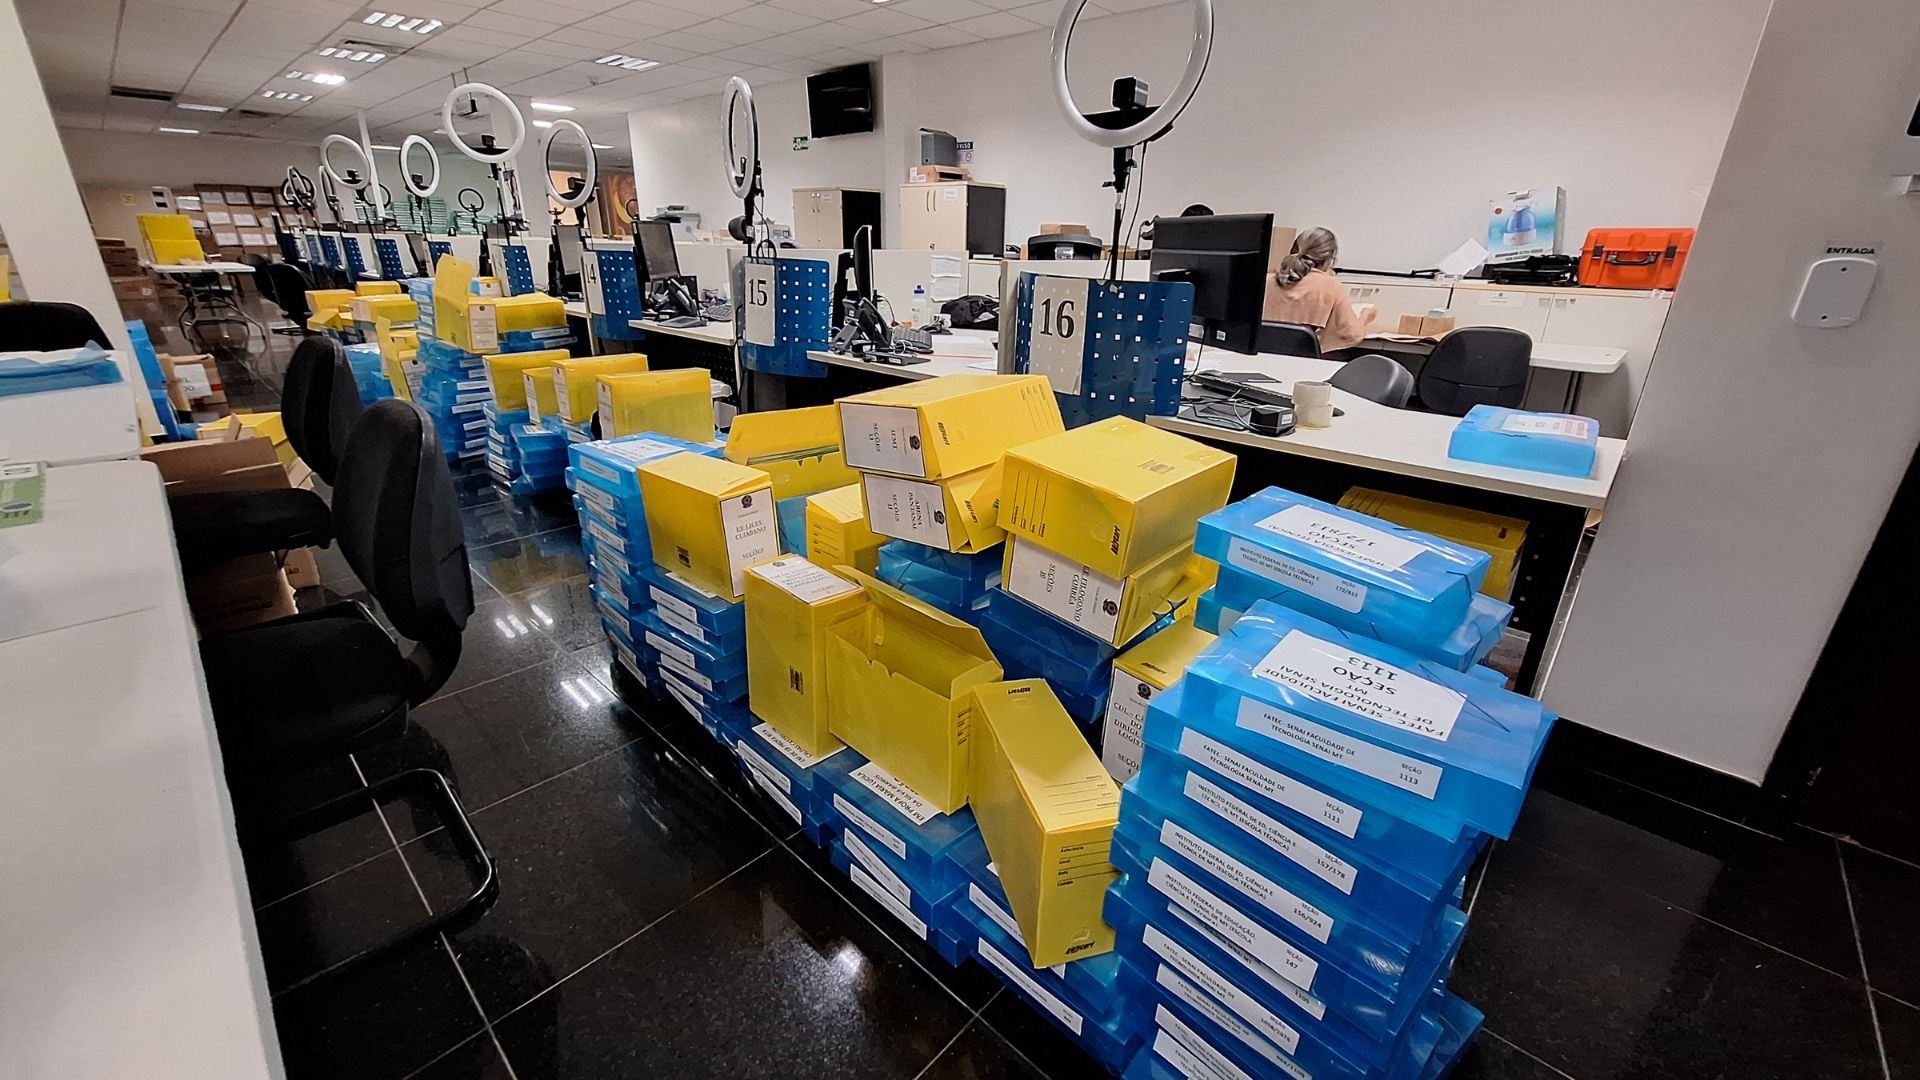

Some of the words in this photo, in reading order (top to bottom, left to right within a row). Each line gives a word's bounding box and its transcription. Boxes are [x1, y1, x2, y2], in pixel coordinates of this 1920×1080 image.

[1826, 247, 1875, 255] ENTRADA
[586, 263, 597, 284] 14
[748, 278, 768, 307] 15
[1040, 297, 1075, 339] 16
[1239, 546, 1261, 558] INSTITUTO
[1262, 554, 1281, 566] FEDERAL
[1047, 563, 1057, 594] SEÇÕES
[1069, 574, 1080, 606] CORRÊA
[1279, 664, 1317, 684] SENAI
[1346, 655, 1398, 681] 1113
[1261, 666, 1339, 702] FACULDADE
[1331, 664, 1397, 695] SEÇÃO
[1345, 683, 1368, 695] MT
[1319, 681, 1409, 718] TECNOLOGIA
[1341, 699, 1384, 718] SENAI
[1395, 717, 1443, 736] FATEC
[1412, 714, 1432, 725] DE
[1263, 713, 1282, 725] FATEC
[1286, 722, 1306, 735] SENAI
[1306, 731, 1345, 751] FACULDADE
[1345, 747, 1355, 756] DE
[1270, 724, 1311, 746] TECNOLOGIA
[1311, 742, 1331, 754] SENAI
[1331, 750, 1343, 759] MT
[1202, 744, 1220, 757] FATEC
[1223, 755, 1241, 768] SENAI
[1241, 764, 1275, 786] FACULDADE
[1275, 783, 1285, 791] DE
[1209, 755, 1246, 778] TECNOLOGIA
[1245, 775, 1264, 788] SENAI
[1263, 785, 1274, 793] MT
[1400, 762, 1422, 775] SEÇÃO
[856, 771, 876, 785] LUCILA
[874, 773, 897, 790] BARROS
[1398, 772, 1419, 785] 1113
[875, 783, 895, 799] MARIA
[895, 788, 912, 801] SILVA
[893, 796, 914, 813] PROFA
[911, 799, 922, 808] DA
[1197, 783, 1226, 803] INSTITUTO
[1225, 800, 1249, 818] FEDERAL
[1248, 815, 1258, 823] DE
[1267, 825, 1292, 844] CIÊNCIA
[1325, 801, 1344, 814] SEÇÃO
[913, 811, 924, 821] EM
[1322, 810, 1341, 823] 1111
[1229, 810, 1240, 820] MT
[1238, 816, 1262, 834] (ESCOLA
[1261, 830, 1291, 851] TÉCNICA)
[1174, 831, 1202, 851] INSTITUTO
[1201, 848, 1226, 866] FEDERAL
[1226, 863, 1235, 871] DE
[1244, 874, 1270, 893] CIÊNCIA
[1315, 857, 1346, 880] 157/178
[1323, 852, 1343, 867] SEÇÃO
[1197, 853, 1207, 861] DE
[1206, 858, 1216, 867] MT
[1215, 864, 1240, 883] (ESCOLA
[1238, 878, 1268, 900] TÉCNICA)
[1164, 872, 1192, 894] INSTITUTO
[1191, 891, 1215, 910] FEDERAL
[1214, 908, 1224, 916] DE
[1164, 879, 1186, 897] CIÊNCIA
[1210, 912, 1219, 920] DE
[1218, 918, 1229, 927] MT
[1292, 907, 1322, 929] 156/924
[1300, 901, 1319, 916] SEÇÃO
[1283, 957, 1298, 970] 147
[1285, 947, 1304, 963] SEÇÃO
[1195, 968, 1227, 992] FACULDADE
